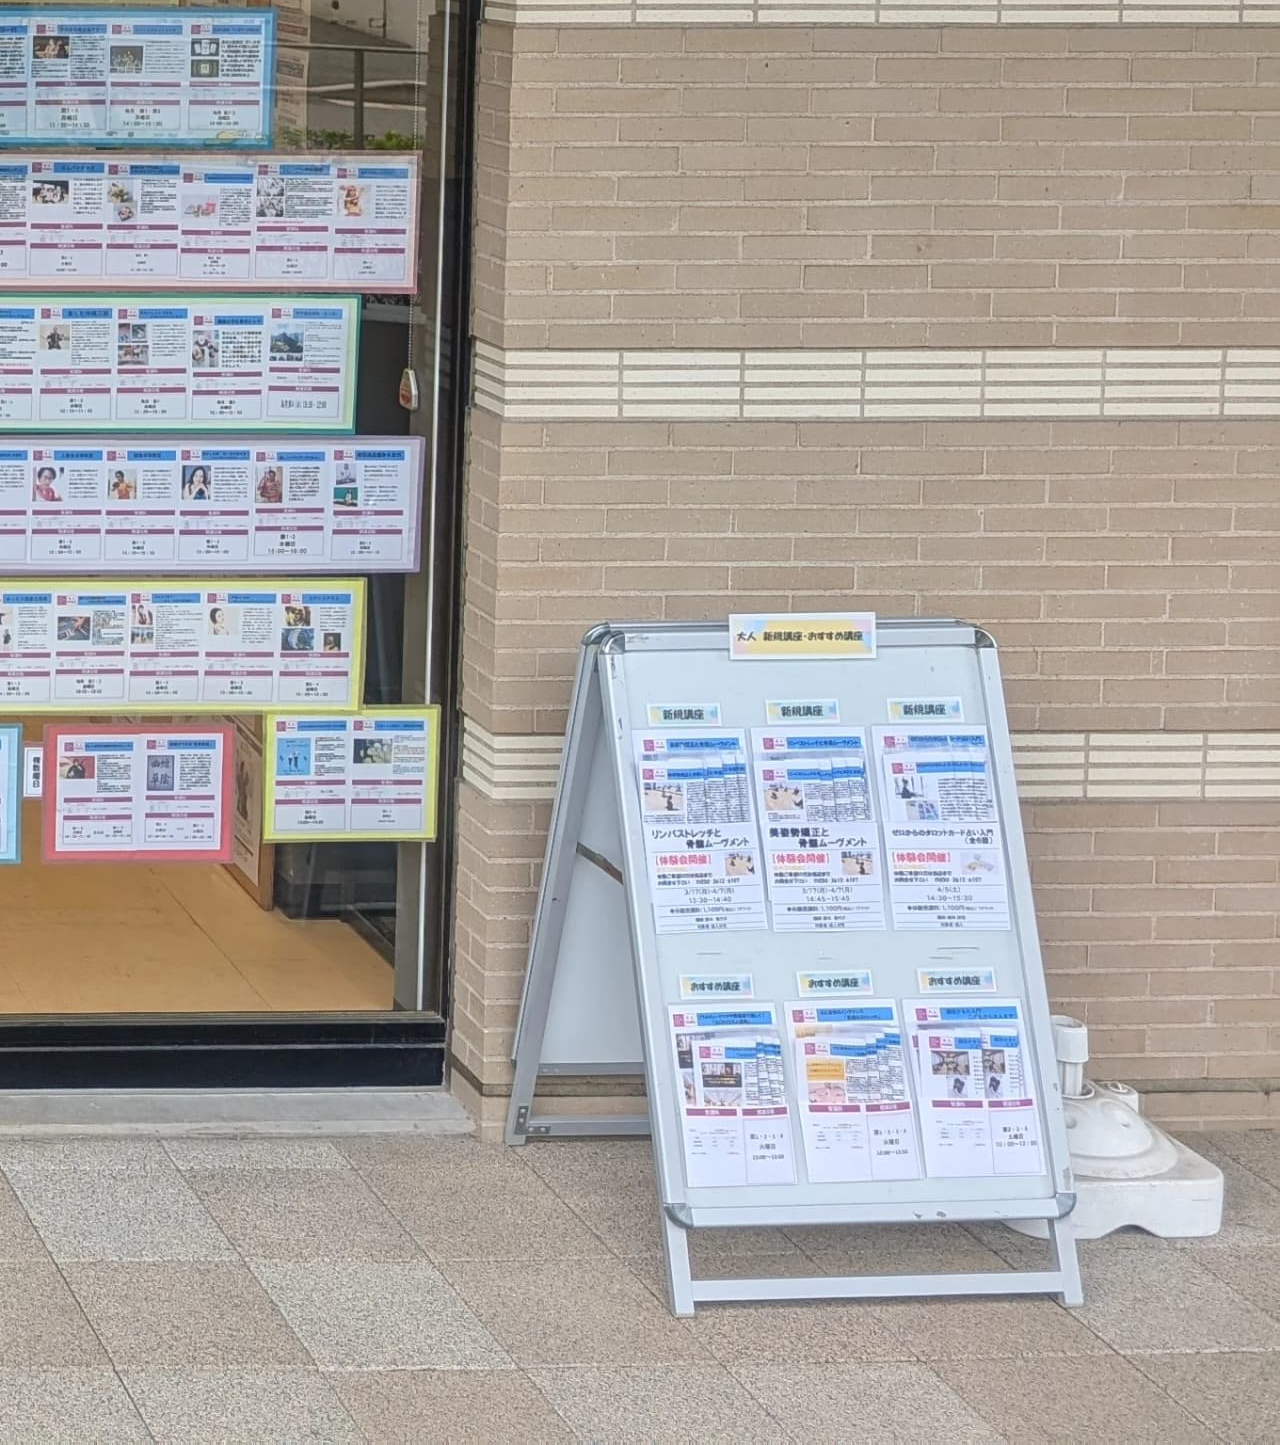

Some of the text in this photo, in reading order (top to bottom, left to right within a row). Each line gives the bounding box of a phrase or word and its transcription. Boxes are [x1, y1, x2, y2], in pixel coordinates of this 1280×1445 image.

[737, 631, 757, 642] 大人
[663, 709, 704, 721] 新規講座
[781, 705, 824, 717] 新規講座
[903, 703, 946, 716] 新規講座
[689, 980, 741, 992] おすすめ講座
[807, 977, 860, 990] おすすめ講座
[927, 974, 981, 987] おすすめ講座
